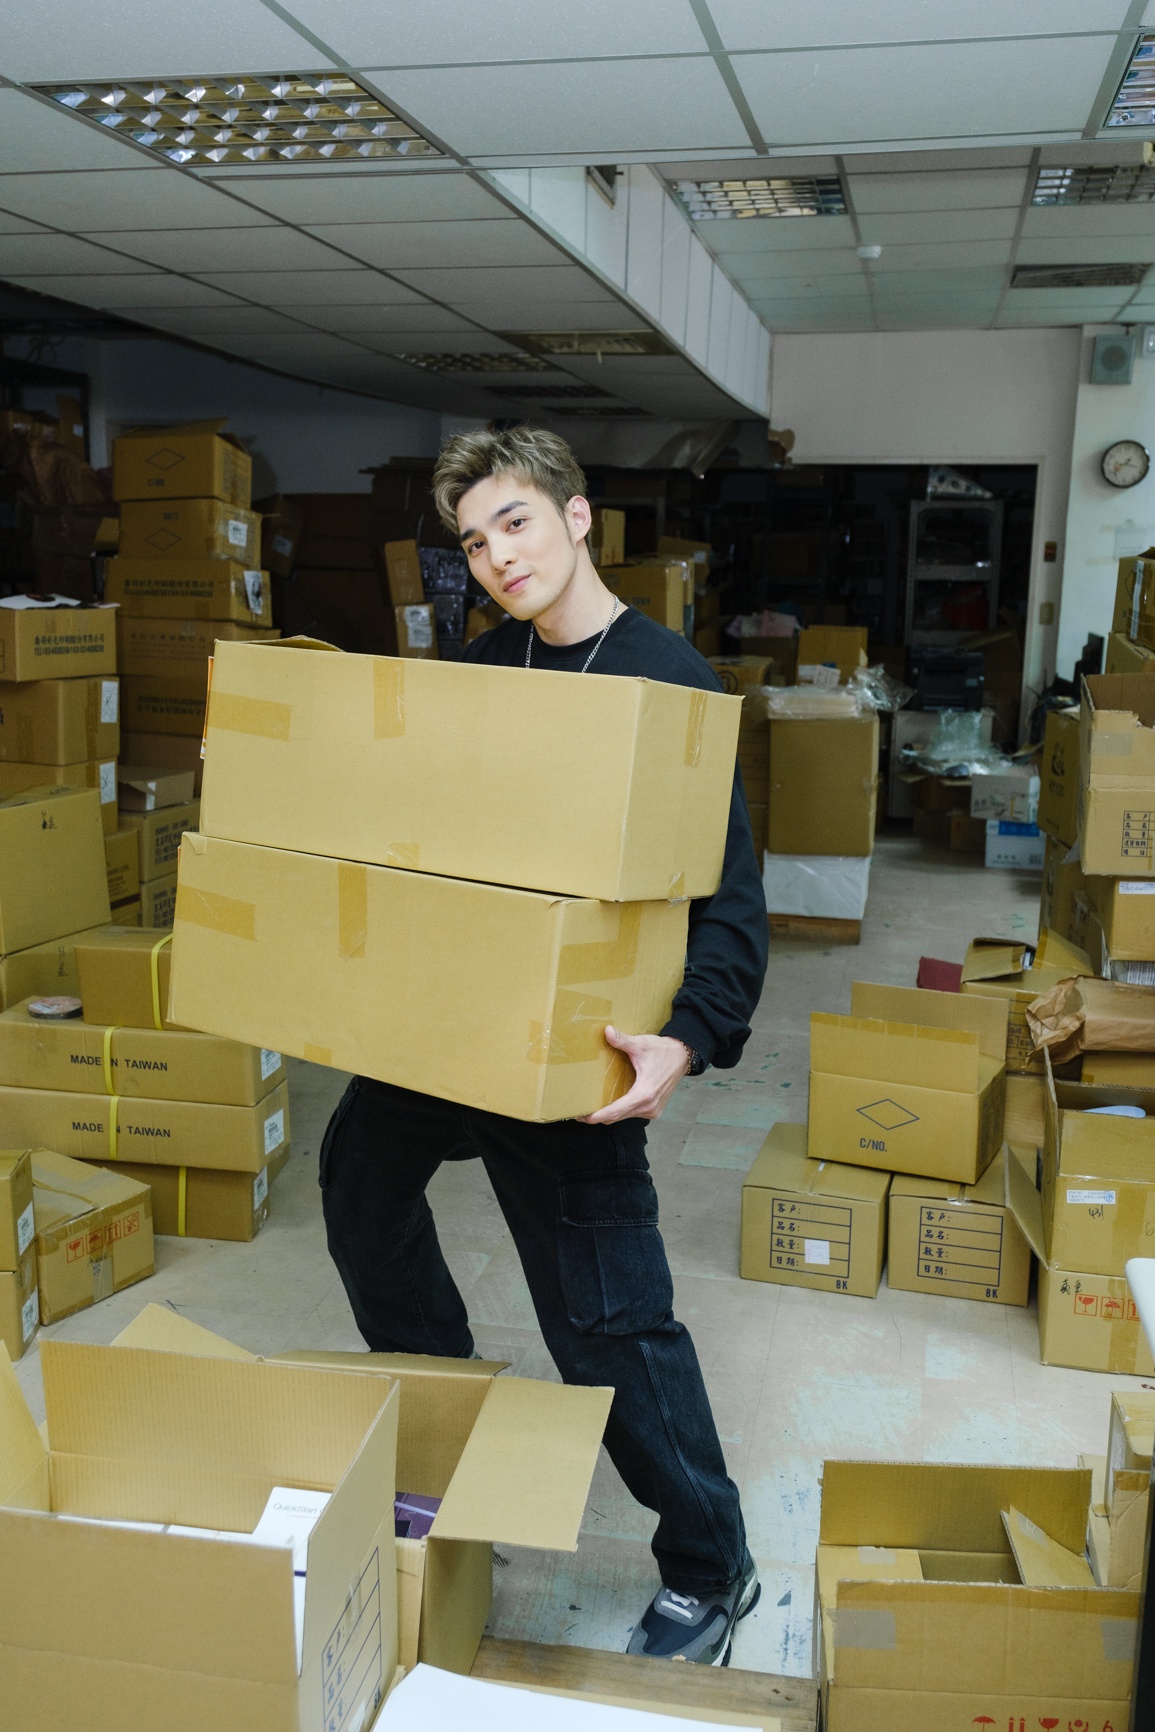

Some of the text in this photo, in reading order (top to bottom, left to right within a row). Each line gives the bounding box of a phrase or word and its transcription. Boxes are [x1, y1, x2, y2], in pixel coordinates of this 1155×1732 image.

[70, 1054, 102, 1066] MADE
[124, 1058, 168, 1071] TAIWAN
[72, 1121, 104, 1133] MADE
[126, 1125, 171, 1138] TAIWAN
[860, 1137, 888, 1152] C/NO.
[836, 1279, 848, 1290] 8K
[985, 1288, 998, 1299] 8K
[273, 1502, 318, 1514] QuickStart
